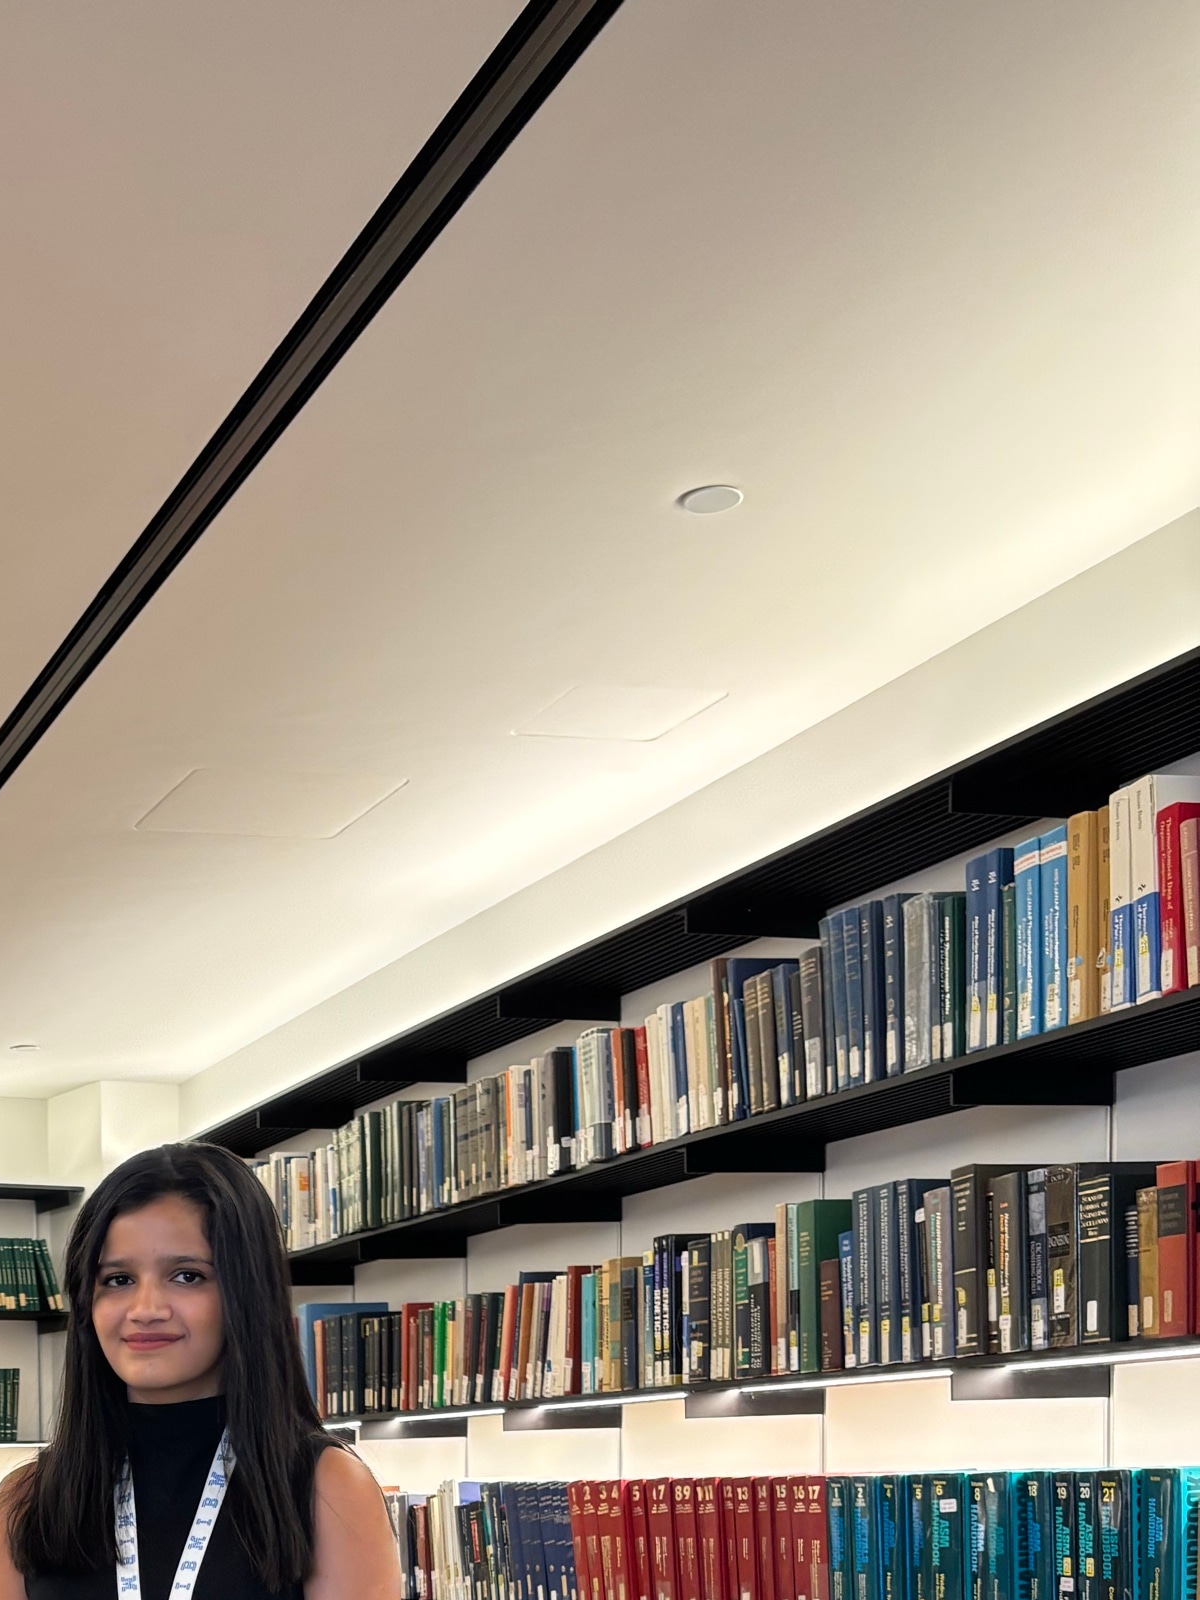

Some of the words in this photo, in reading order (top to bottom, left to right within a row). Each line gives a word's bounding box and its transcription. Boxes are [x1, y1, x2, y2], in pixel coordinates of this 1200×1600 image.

[583, 1486, 592, 1500] 2
[600, 1485, 608, 1500] 3
[611, 1484, 619, 1500] 4
[633, 1486, 641, 1501] 5
[658, 1485, 666, 1500] 7
[675, 1485, 683, 1501] 8
[683, 1485, 691, 1500] 9
[704, 1485, 714, 1500] 11
[737, 1486, 749, 1501] 13
[758, 1485, 767, 1500] 14
[776, 1485, 787, 1499] 15
[793, 1485, 805, 1500] 16
[808, 1485, 821, 1500] 17
[857, 1488, 864, 1499] 2
[886, 1488, 891, 1498] 4
[916, 1488, 922, 1500] 5
[936, 1485, 943, 1496] 6
[974, 1488, 981, 1501] 8
[1028, 1486, 1038, 1497] 18
[1057, 1488, 1067, 1500] 19
[1080, 1488, 1090, 1499] 20
[1103, 1488, 1114, 1502] 21
[196, 1472, 226, 1527] IBM
[932, 1500, 940, 1566] HANDBOOK
[940, 1520, 950, 1548] ASM
[1148, 1498, 1156, 1558] HANDBOOK
[977, 1523, 985, 1552] ASM
[996, 1527, 1004, 1555] ASM
[1033, 1523, 1041, 1552] ASM
[1056, 1506, 1064, 1576] HANDBOOK
[1063, 1526, 1071, 1556] ASM
[1086, 1524, 1094, 1554] ASM
[1101, 1506, 1112, 1580] HANDBOOK
[1111, 1526, 1119, 1557] ASM
[120, 1538, 138, 1593] IBM
[175, 1536, 207, 1591] IBM
